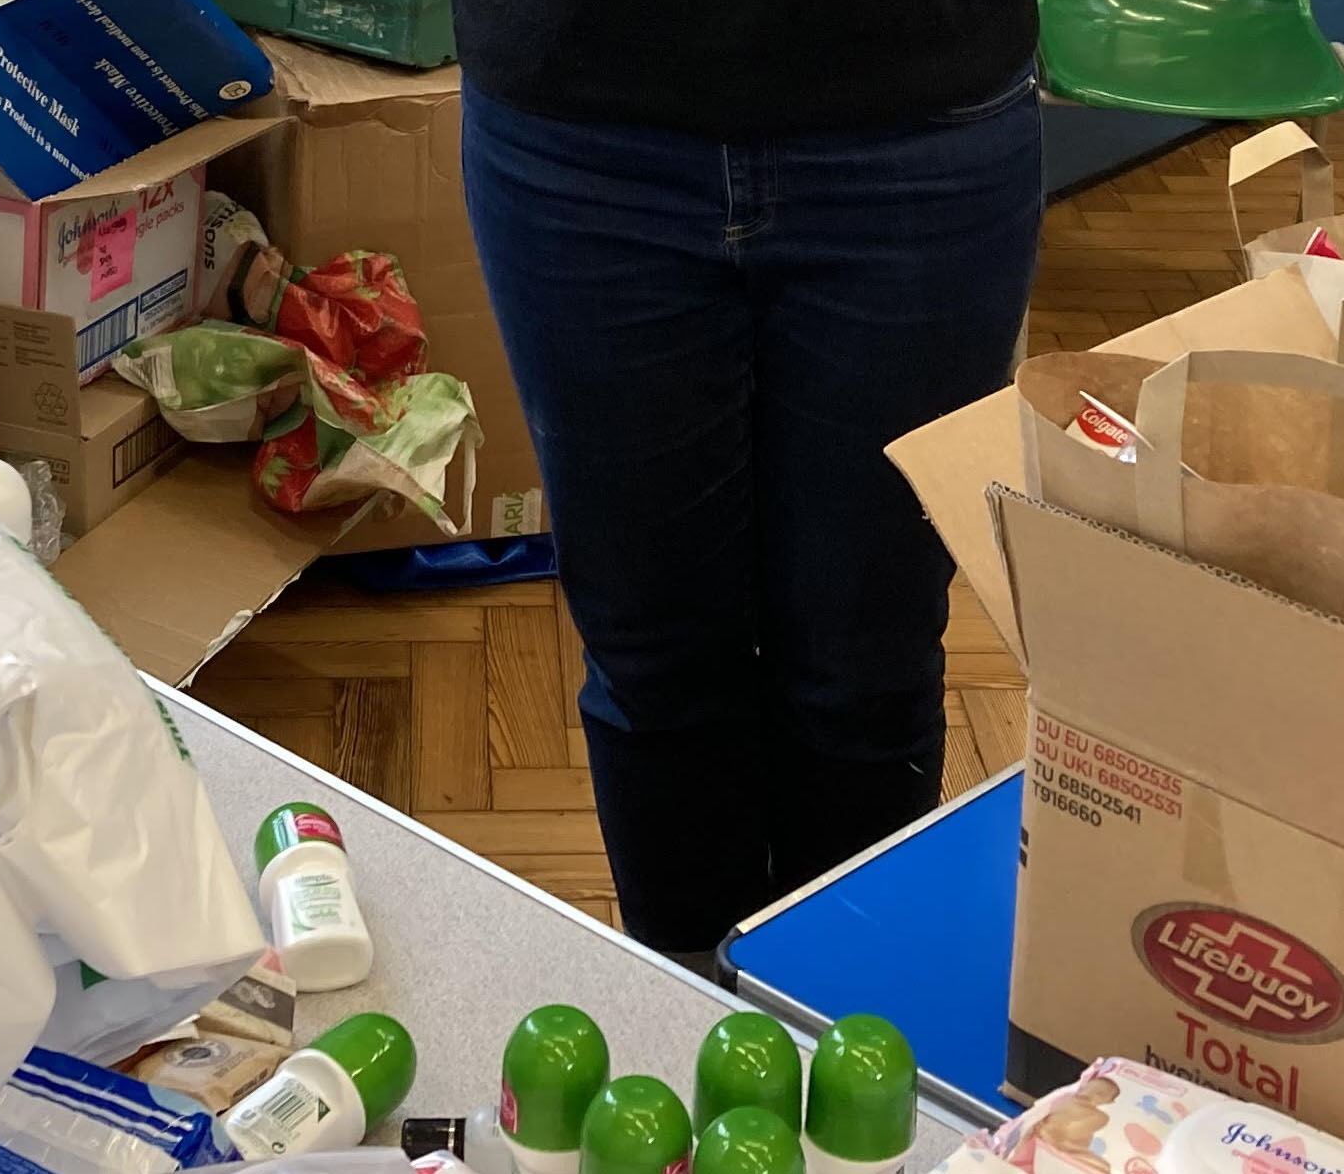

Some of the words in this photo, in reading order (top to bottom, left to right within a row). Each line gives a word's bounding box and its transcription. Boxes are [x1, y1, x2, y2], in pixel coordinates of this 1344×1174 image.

[99, 12, 135, 49] medical
[93, 57, 132, 89] Mask
[131, 44, 150, 63] non
[148, 57, 156, 68] a
[151, 64, 162, 75] is
[159, 71, 191, 106] Product
[48, 97, 80, 138] Mask
[126, 85, 182, 137] Protective
[3, 98, 36, 139] Product
[36, 130, 45, 146] is
[44, 141, 52, 152] a
[51, 147, 69, 168] non
[156, 201, 185, 228] packs
[1081, 408, 1129, 444] Colgate
[1036, 715, 1060, 740] DU
[1064, 729, 1088, 754] EU
[1093, 744, 1182, 796] 68502535
[1033, 758, 1054, 783] TU
[1058, 772, 1142, 824] 68502541
[1035, 737, 1058, 761] DU
[1063, 751, 1093, 777] UKI
[1098, 768, 1183, 819] 68502531
[1032, 779, 1102, 828] T916660
[1158, 920, 1330, 1020] Lifebuoy
[1176, 1010, 1300, 1112] Total
